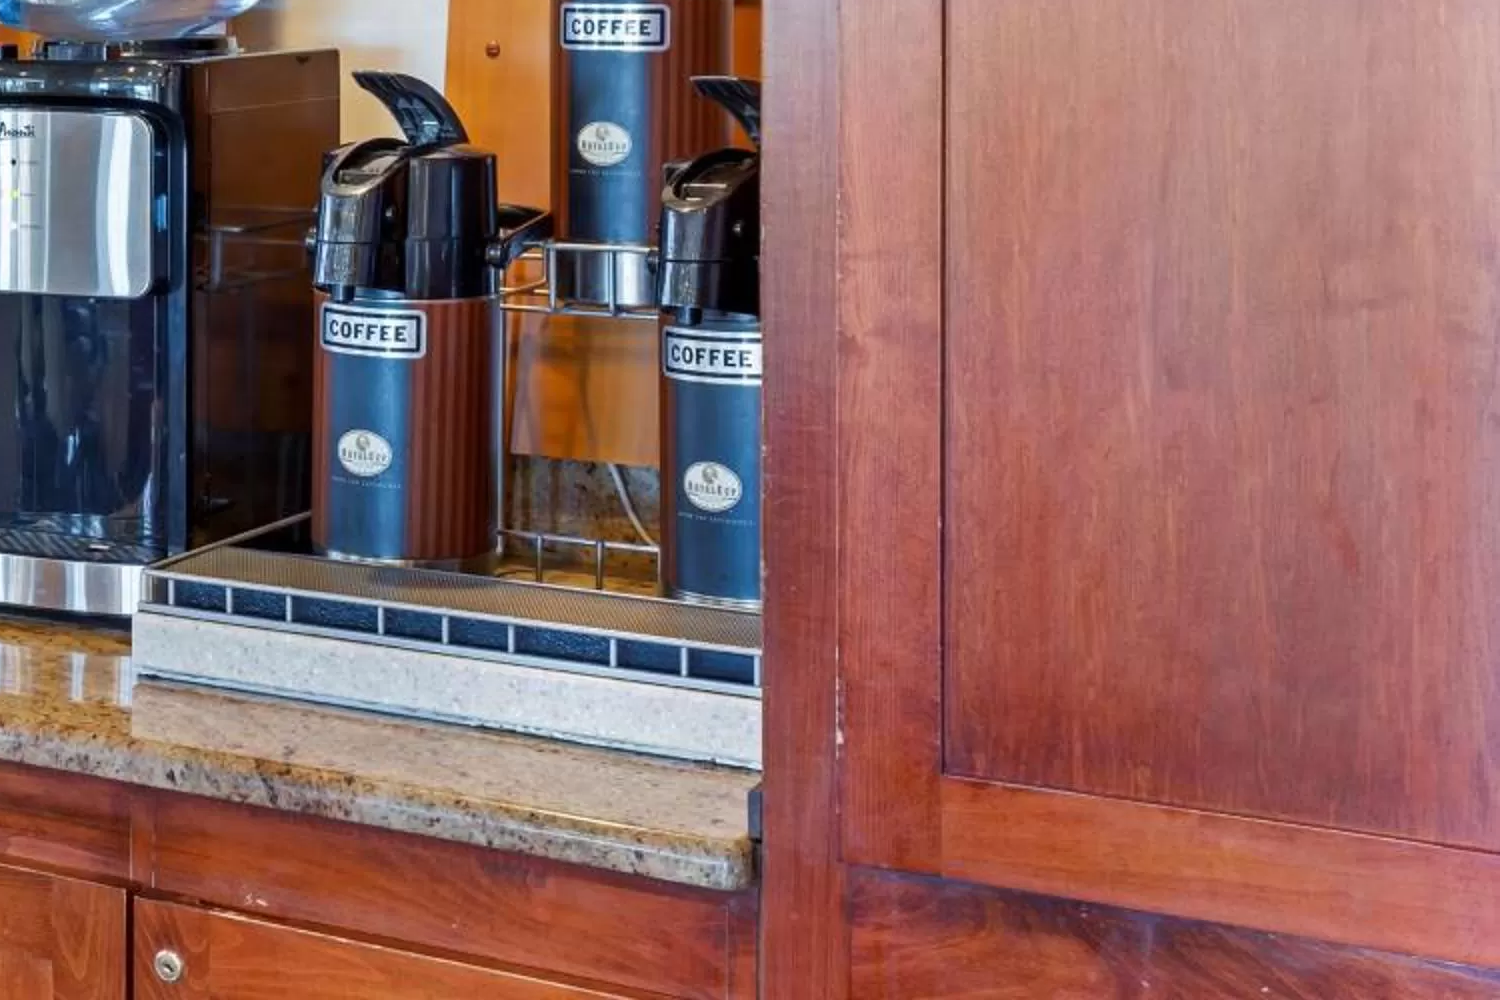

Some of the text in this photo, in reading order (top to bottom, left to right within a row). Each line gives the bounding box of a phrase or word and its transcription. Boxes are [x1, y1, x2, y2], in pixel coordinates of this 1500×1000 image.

[571, 18, 651, 36] COFFEE
[329, 319, 407, 343] COFFEE
[671, 344, 752, 368] COFFEE
